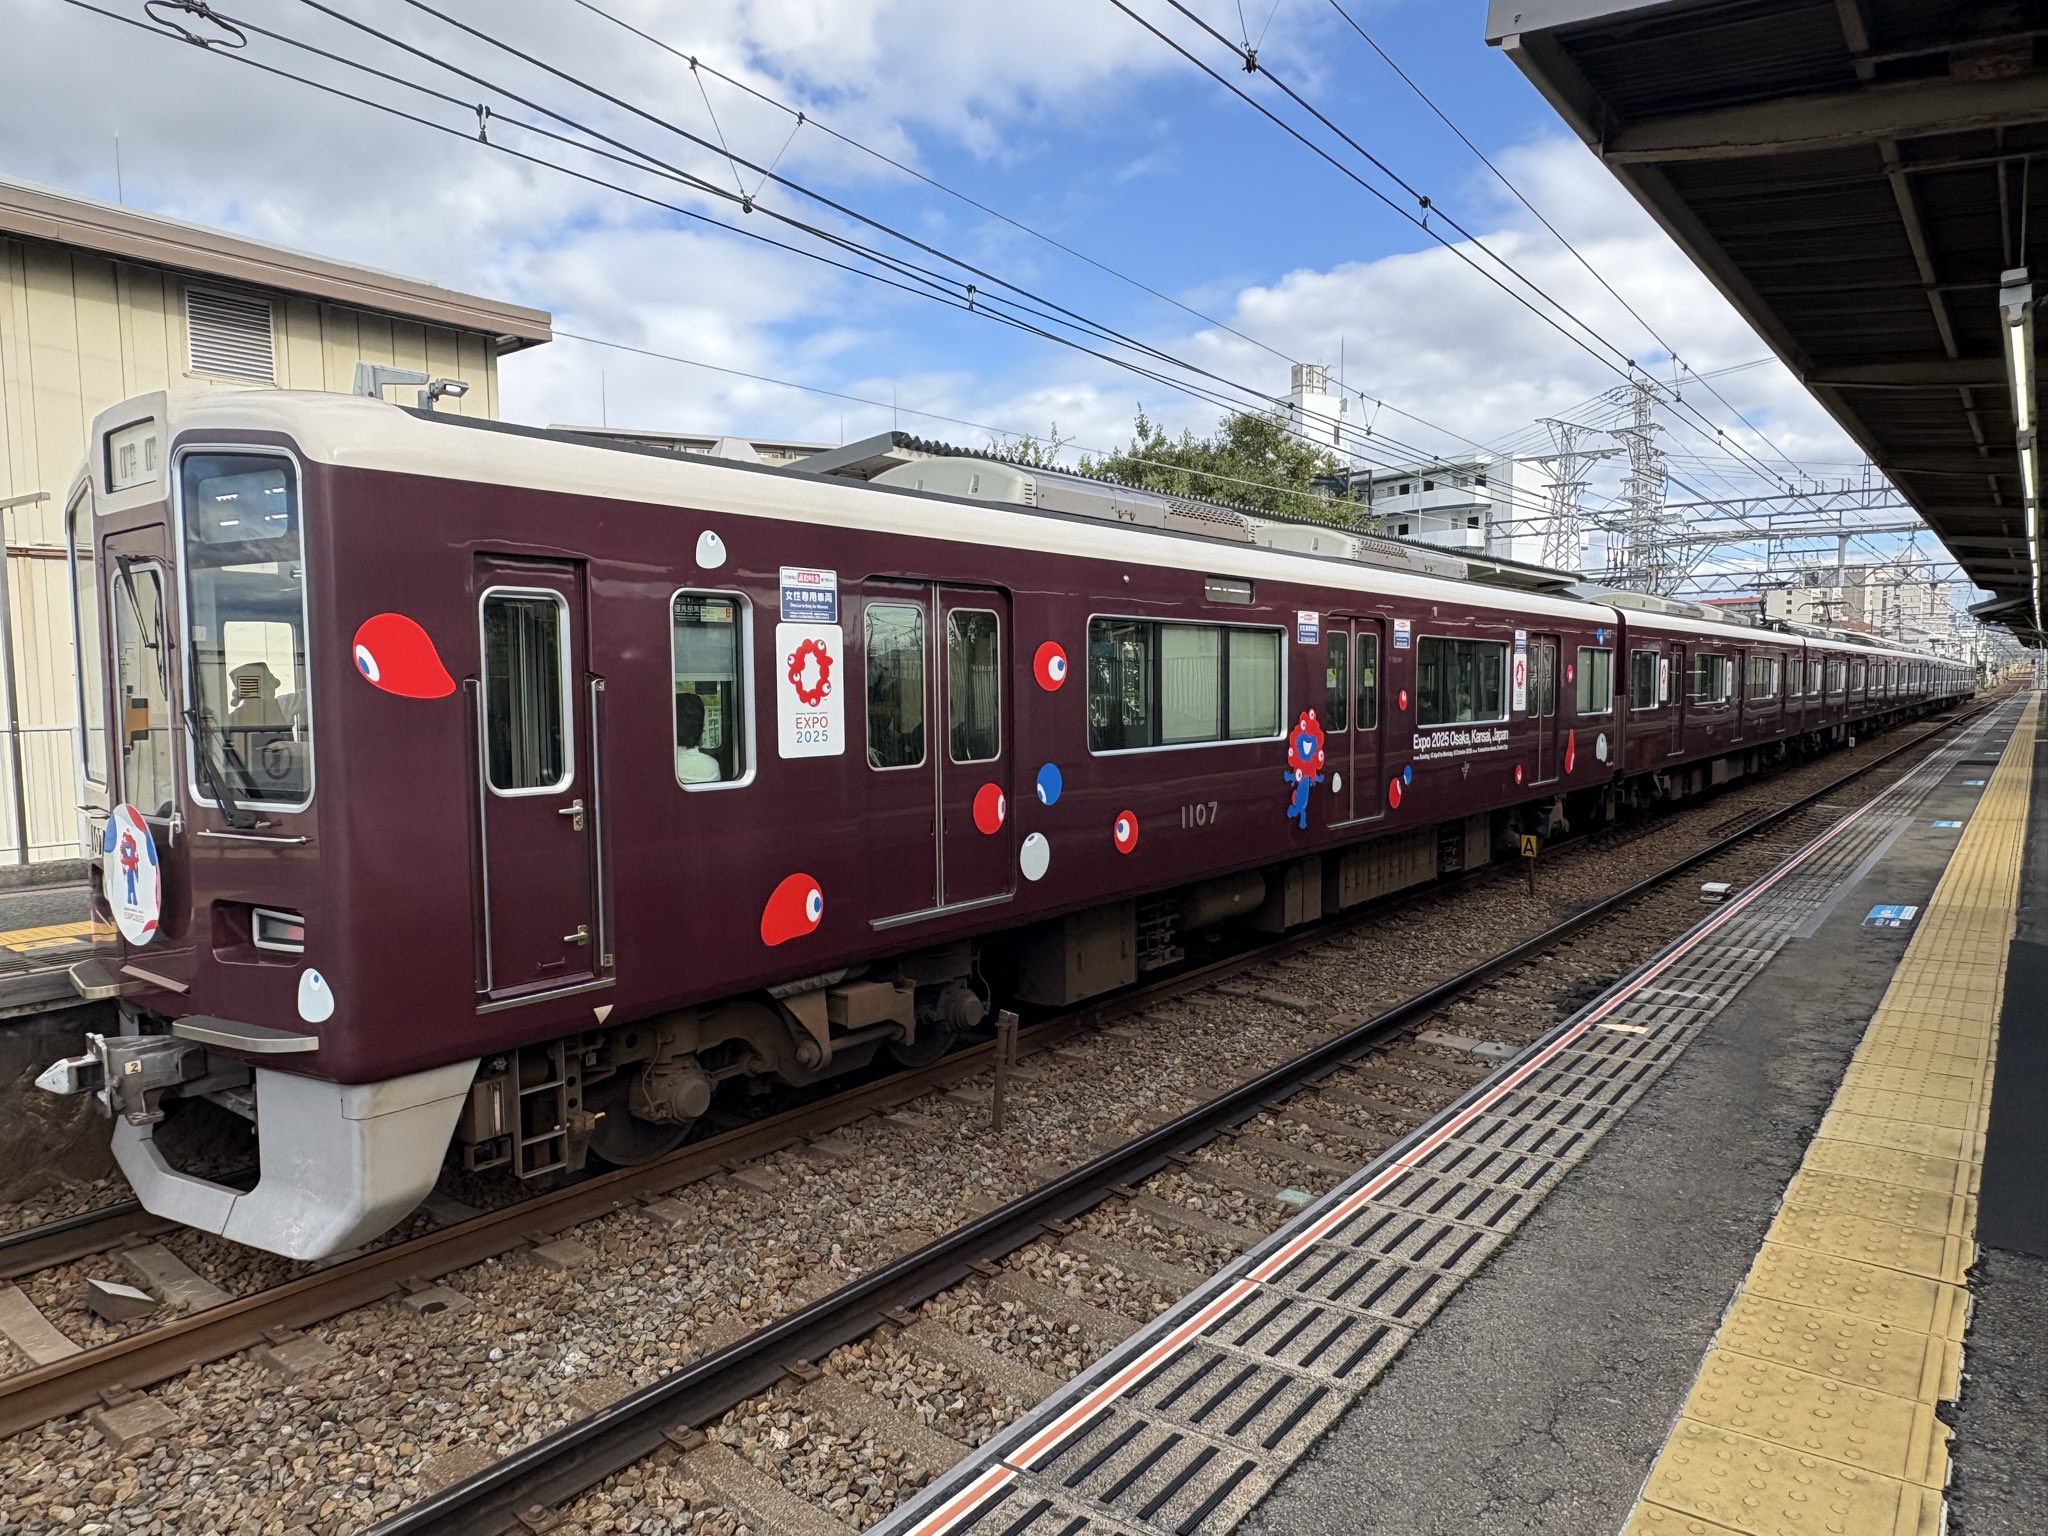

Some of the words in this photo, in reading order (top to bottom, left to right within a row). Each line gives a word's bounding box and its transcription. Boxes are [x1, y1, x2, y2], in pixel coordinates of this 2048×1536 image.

[785, 591, 832, 603] 女性専用車両
[795, 716, 828, 729] EXPO
[796, 730, 828, 743] 2025
[1413, 734, 1430, 751] Expo
[1431, 731, 1449, 747] 2025
[1449, 729, 1471, 746] Osaka,
[1471, 728, 1491, 744] Kansai,
[1492, 727, 1509, 744] Japan
[1181, 801, 1218, 829] 1107
[1523, 837, 1535, 855] A
[130, 1062, 139, 1072] 2
